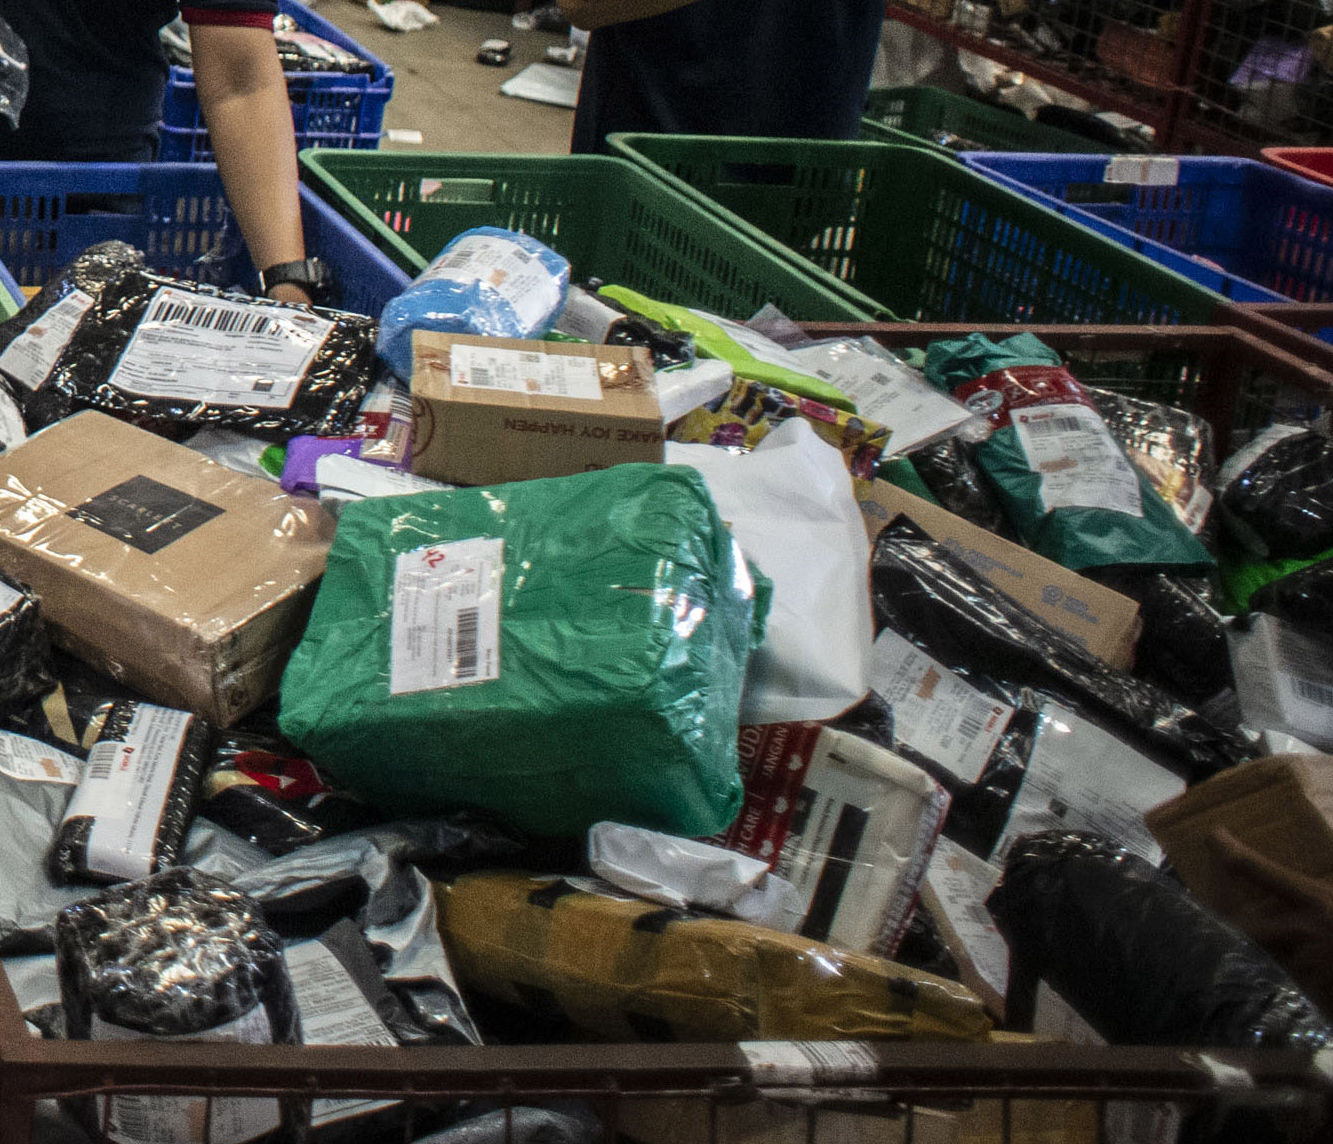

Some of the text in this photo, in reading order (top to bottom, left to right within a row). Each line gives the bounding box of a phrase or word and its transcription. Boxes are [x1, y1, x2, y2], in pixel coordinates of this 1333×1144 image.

[502, 417, 573, 436] HAPPEN
[579, 424, 610, 441] JOY
[419, 547, 446, 569] 42
[759, 725, 790, 778] JANGAN
[738, 803, 763, 841] CARE
